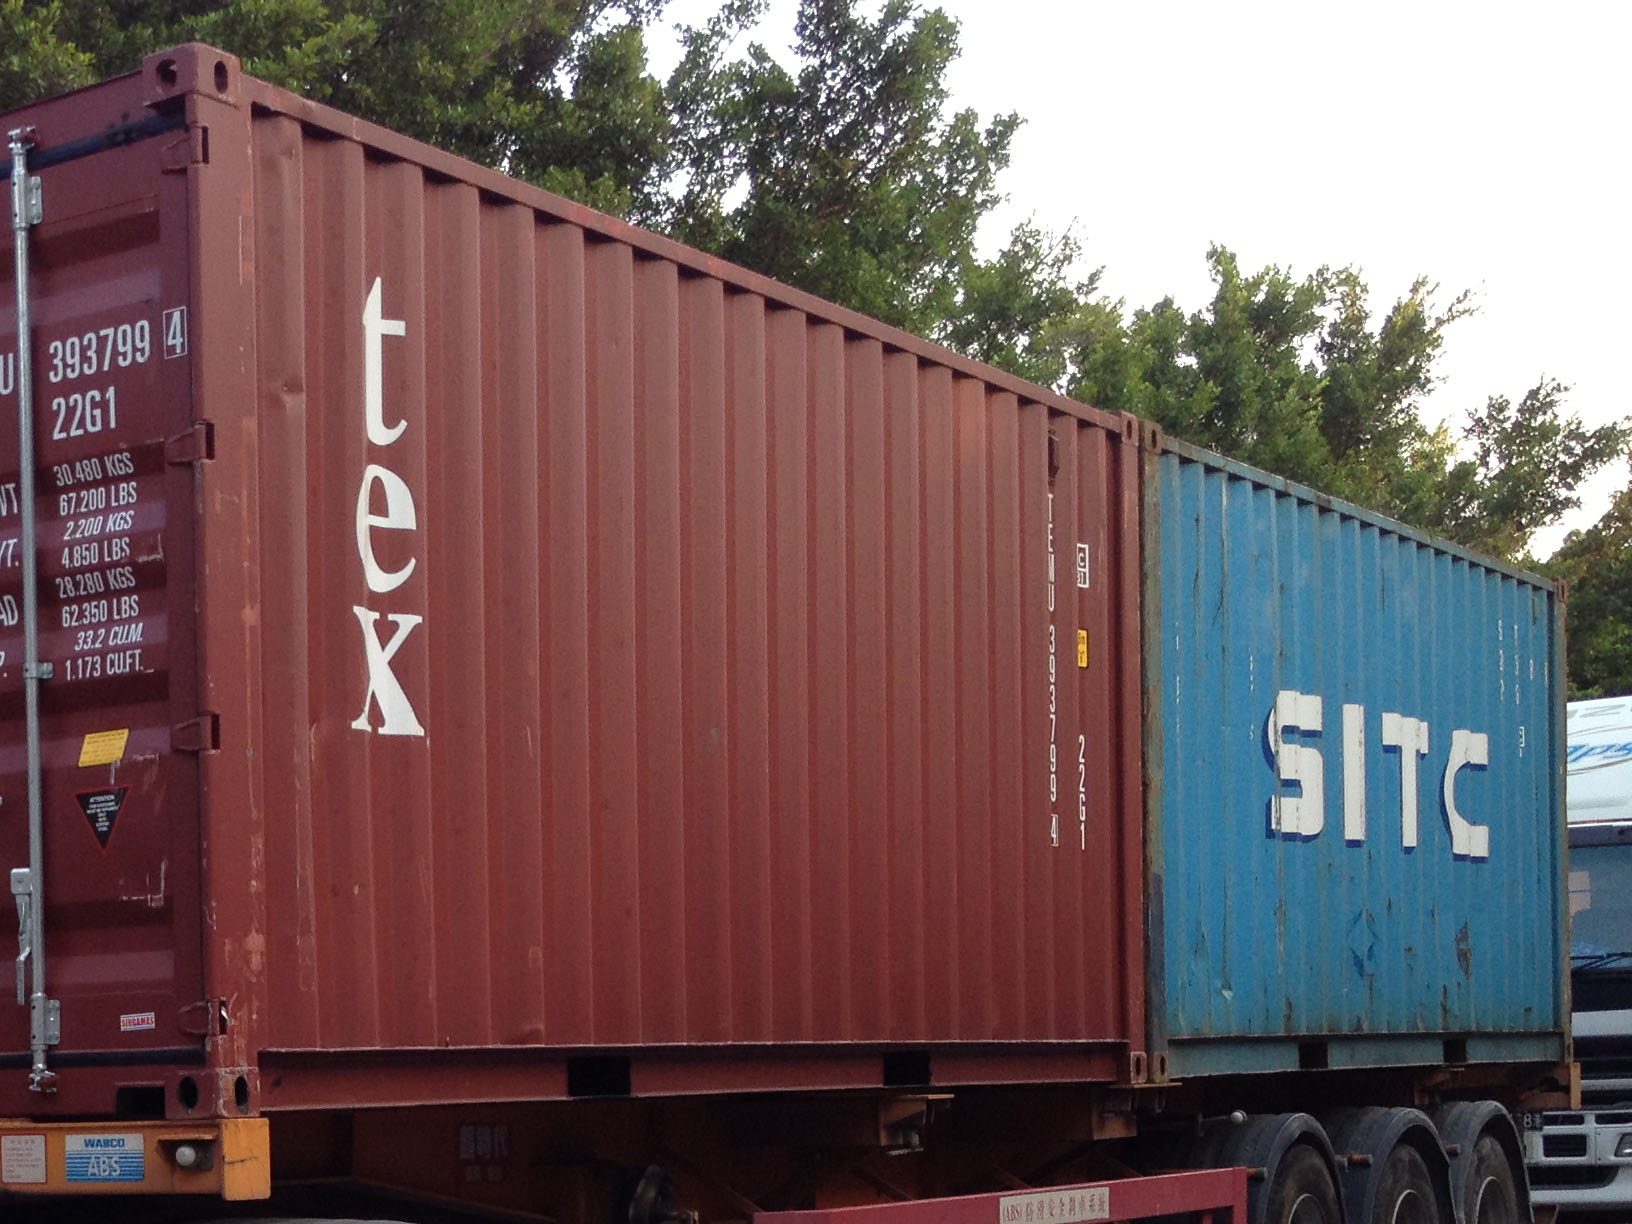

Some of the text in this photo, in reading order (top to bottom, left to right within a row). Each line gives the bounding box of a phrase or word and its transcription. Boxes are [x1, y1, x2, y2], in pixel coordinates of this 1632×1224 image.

[48, 319, 151, 384] 393799
[166, 309, 185, 355] 4
[52, 386, 117, 441] 22G1
[53, 452, 135, 487] 30.480 KGS
[59, 481, 137, 516] 67.200 LBS
[350, 276, 425, 737] tex
[63, 510, 135, 541] 2.200 KGS
[61, 537, 130, 569] 4.850 LBS
[1047, 493, 1056, 612] TEMU
[56, 566, 136, 599] 28.280 KGS
[62, 595, 140, 628] 62.350 LBS
[74, 630, 103, 651] 33.2
[65, 657, 102, 682] 1.173
[1048, 624, 1057, 803] 393799
[1078, 734, 1086, 850] 22G1
[1262, 690, 1491, 863] SITC
[83, 1137, 126, 1149] WABCO
[87, 1155, 122, 1177] ABS
